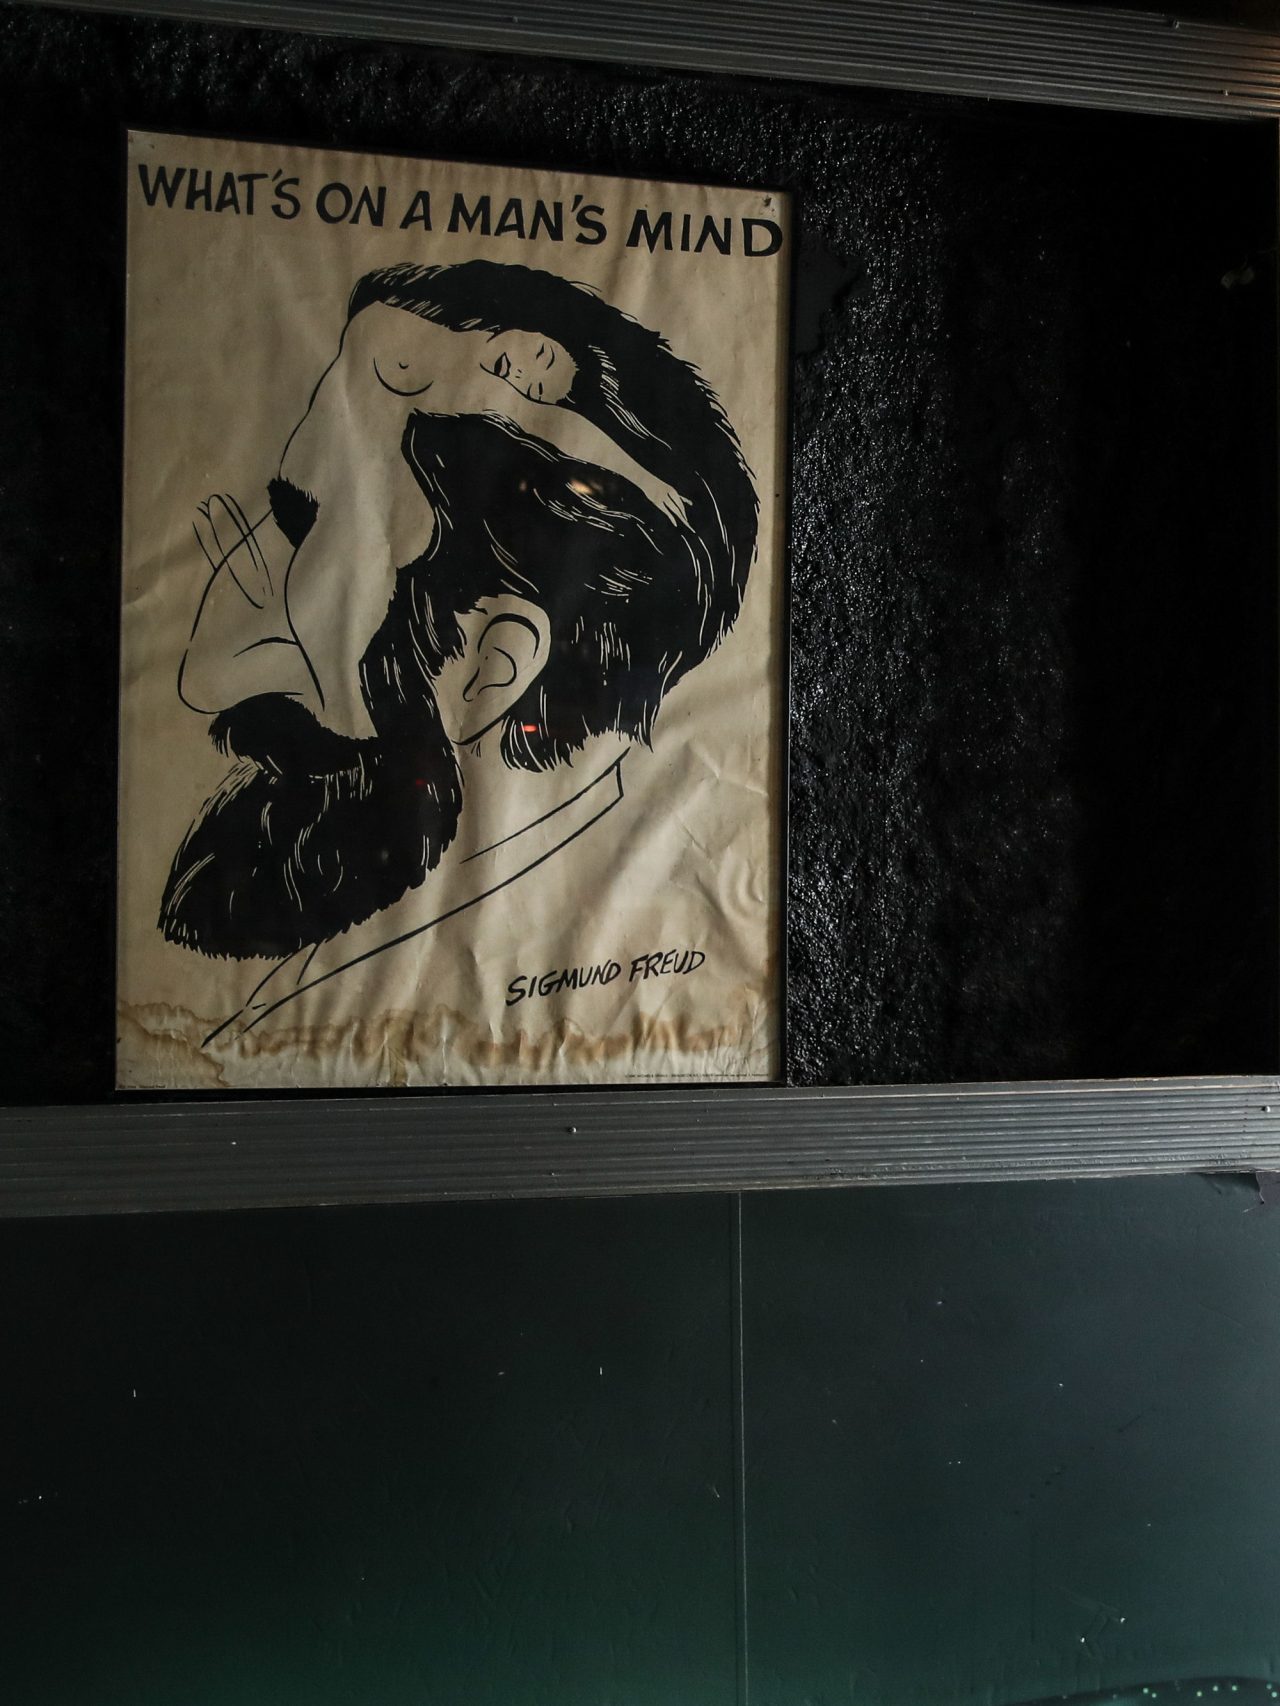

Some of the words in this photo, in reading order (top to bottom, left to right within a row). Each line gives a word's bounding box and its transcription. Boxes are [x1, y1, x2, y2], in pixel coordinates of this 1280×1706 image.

[138, 164, 301, 220] WHAT'S
[316, 181, 384, 228] ON
[400, 190, 434, 232] A
[447, 194, 608, 246] MAN'S
[625, 208, 783, 257] MIND
[505, 959, 622, 1007] SIGMUND
[629, 949, 706, 983] FREUD
